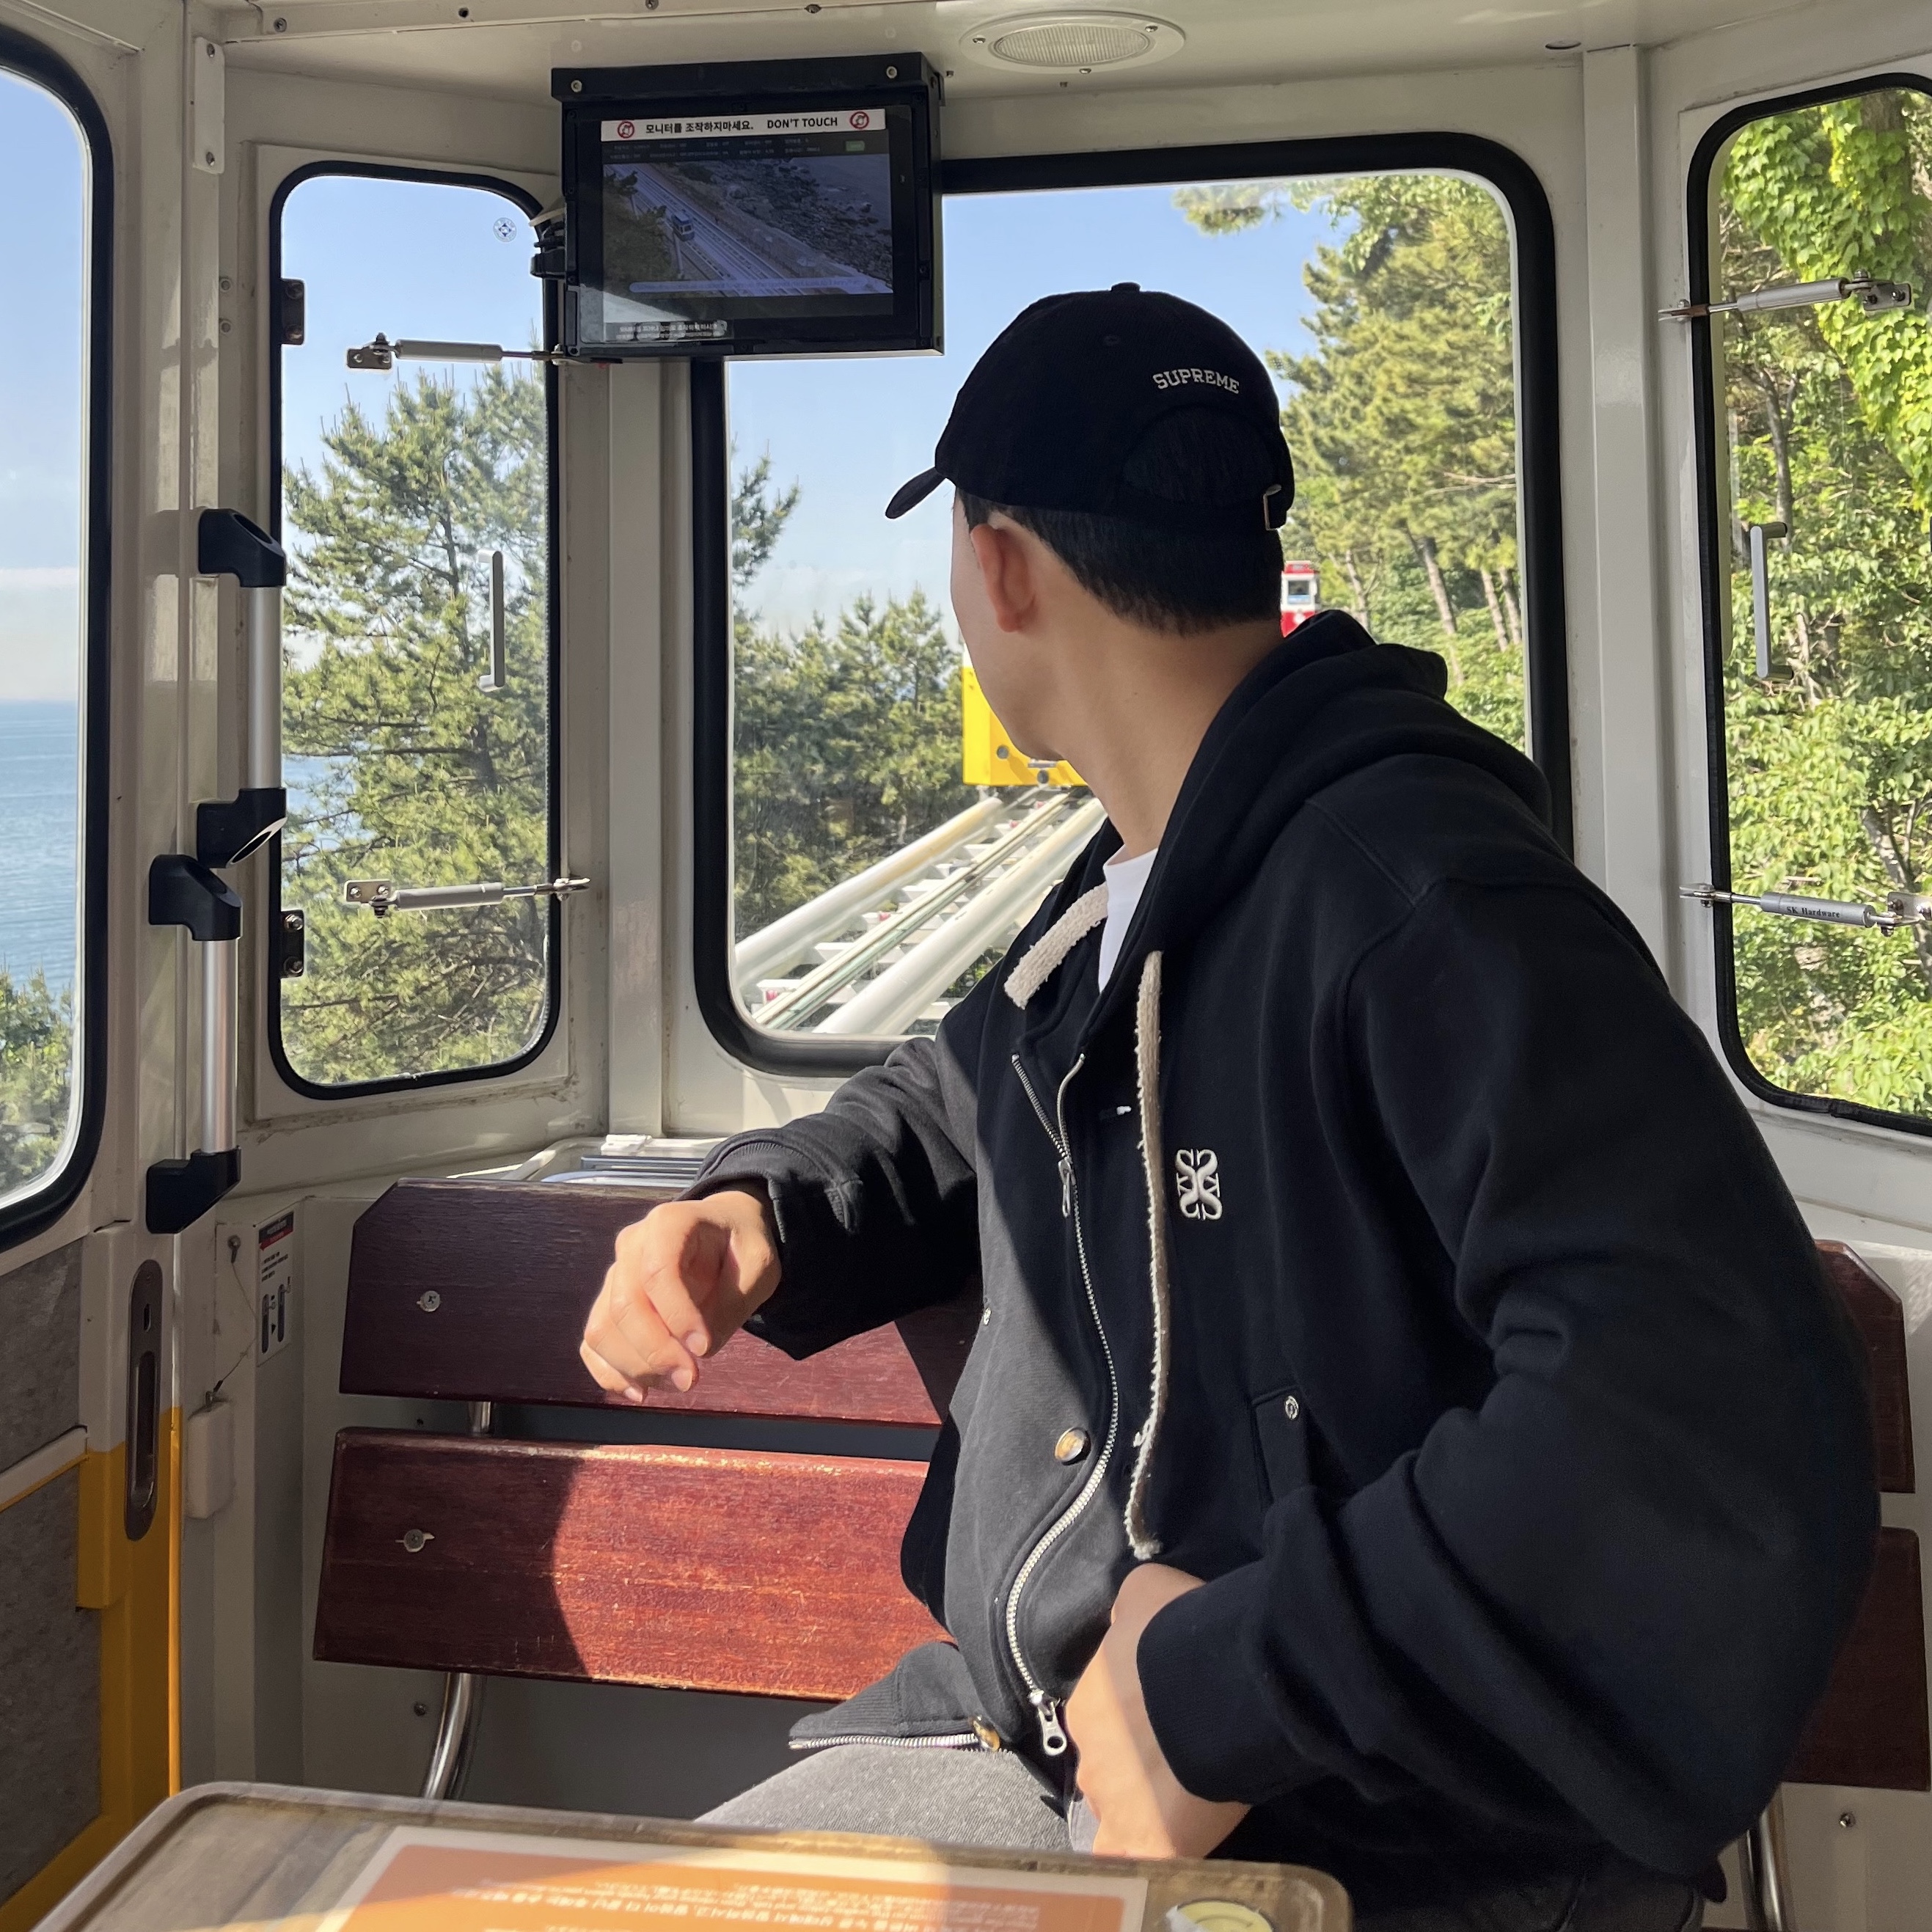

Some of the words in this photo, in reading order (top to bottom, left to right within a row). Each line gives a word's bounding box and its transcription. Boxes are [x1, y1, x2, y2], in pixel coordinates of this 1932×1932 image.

[646, 123, 682, 134] 모니터를
[685, 120, 754, 132] 조작하지마세요.
[767, 118, 799, 128] DON'T
[802, 117, 838, 128] TOUCH
[1152, 368, 1240, 395] SUPREME
[1786, 906, 1799, 914] SK
[1801, 907, 1840, 918] Hardware
